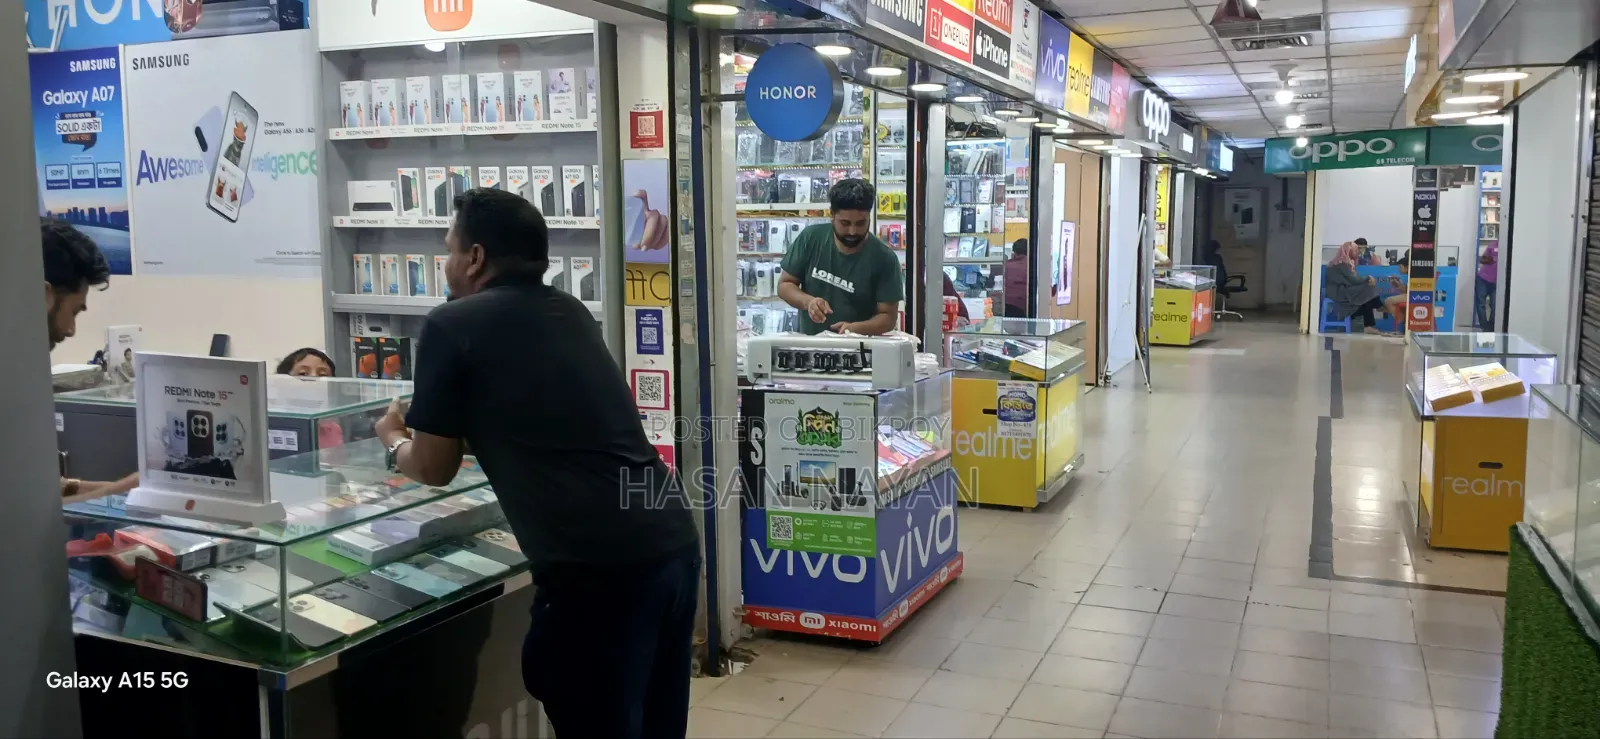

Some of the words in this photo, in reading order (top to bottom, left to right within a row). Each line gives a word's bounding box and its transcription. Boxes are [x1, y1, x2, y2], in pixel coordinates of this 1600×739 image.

[943, 23, 970, 47] ONEPLUS
[132, 53, 190, 70] SAMSUNG
[983, 36, 1008, 68] iPhone
[1041, 39, 1065, 82] vivo
[70, 58, 116, 72] SAMSUNG
[759, 85, 817, 100] HONOR
[1068, 64, 1091, 97] realme
[43, 88, 88, 108] Galaxy
[92, 86, 115, 102] A07
[57, 122, 80, 132] SOLID
[1289, 137, 1395, 164] oppo
[136, 150, 204, 186] Awesome
[164, 385, 192, 397] REDMI
[193, 388, 215, 399] Note
[217, 390, 227, 400] 15
[951, 426, 1032, 461] ealme
[750, 538, 867, 583] vivo
[880, 505, 955, 594] vivo
[754, 610, 796, 624] শাওমি
[828, 619, 877, 633] xiaomi
